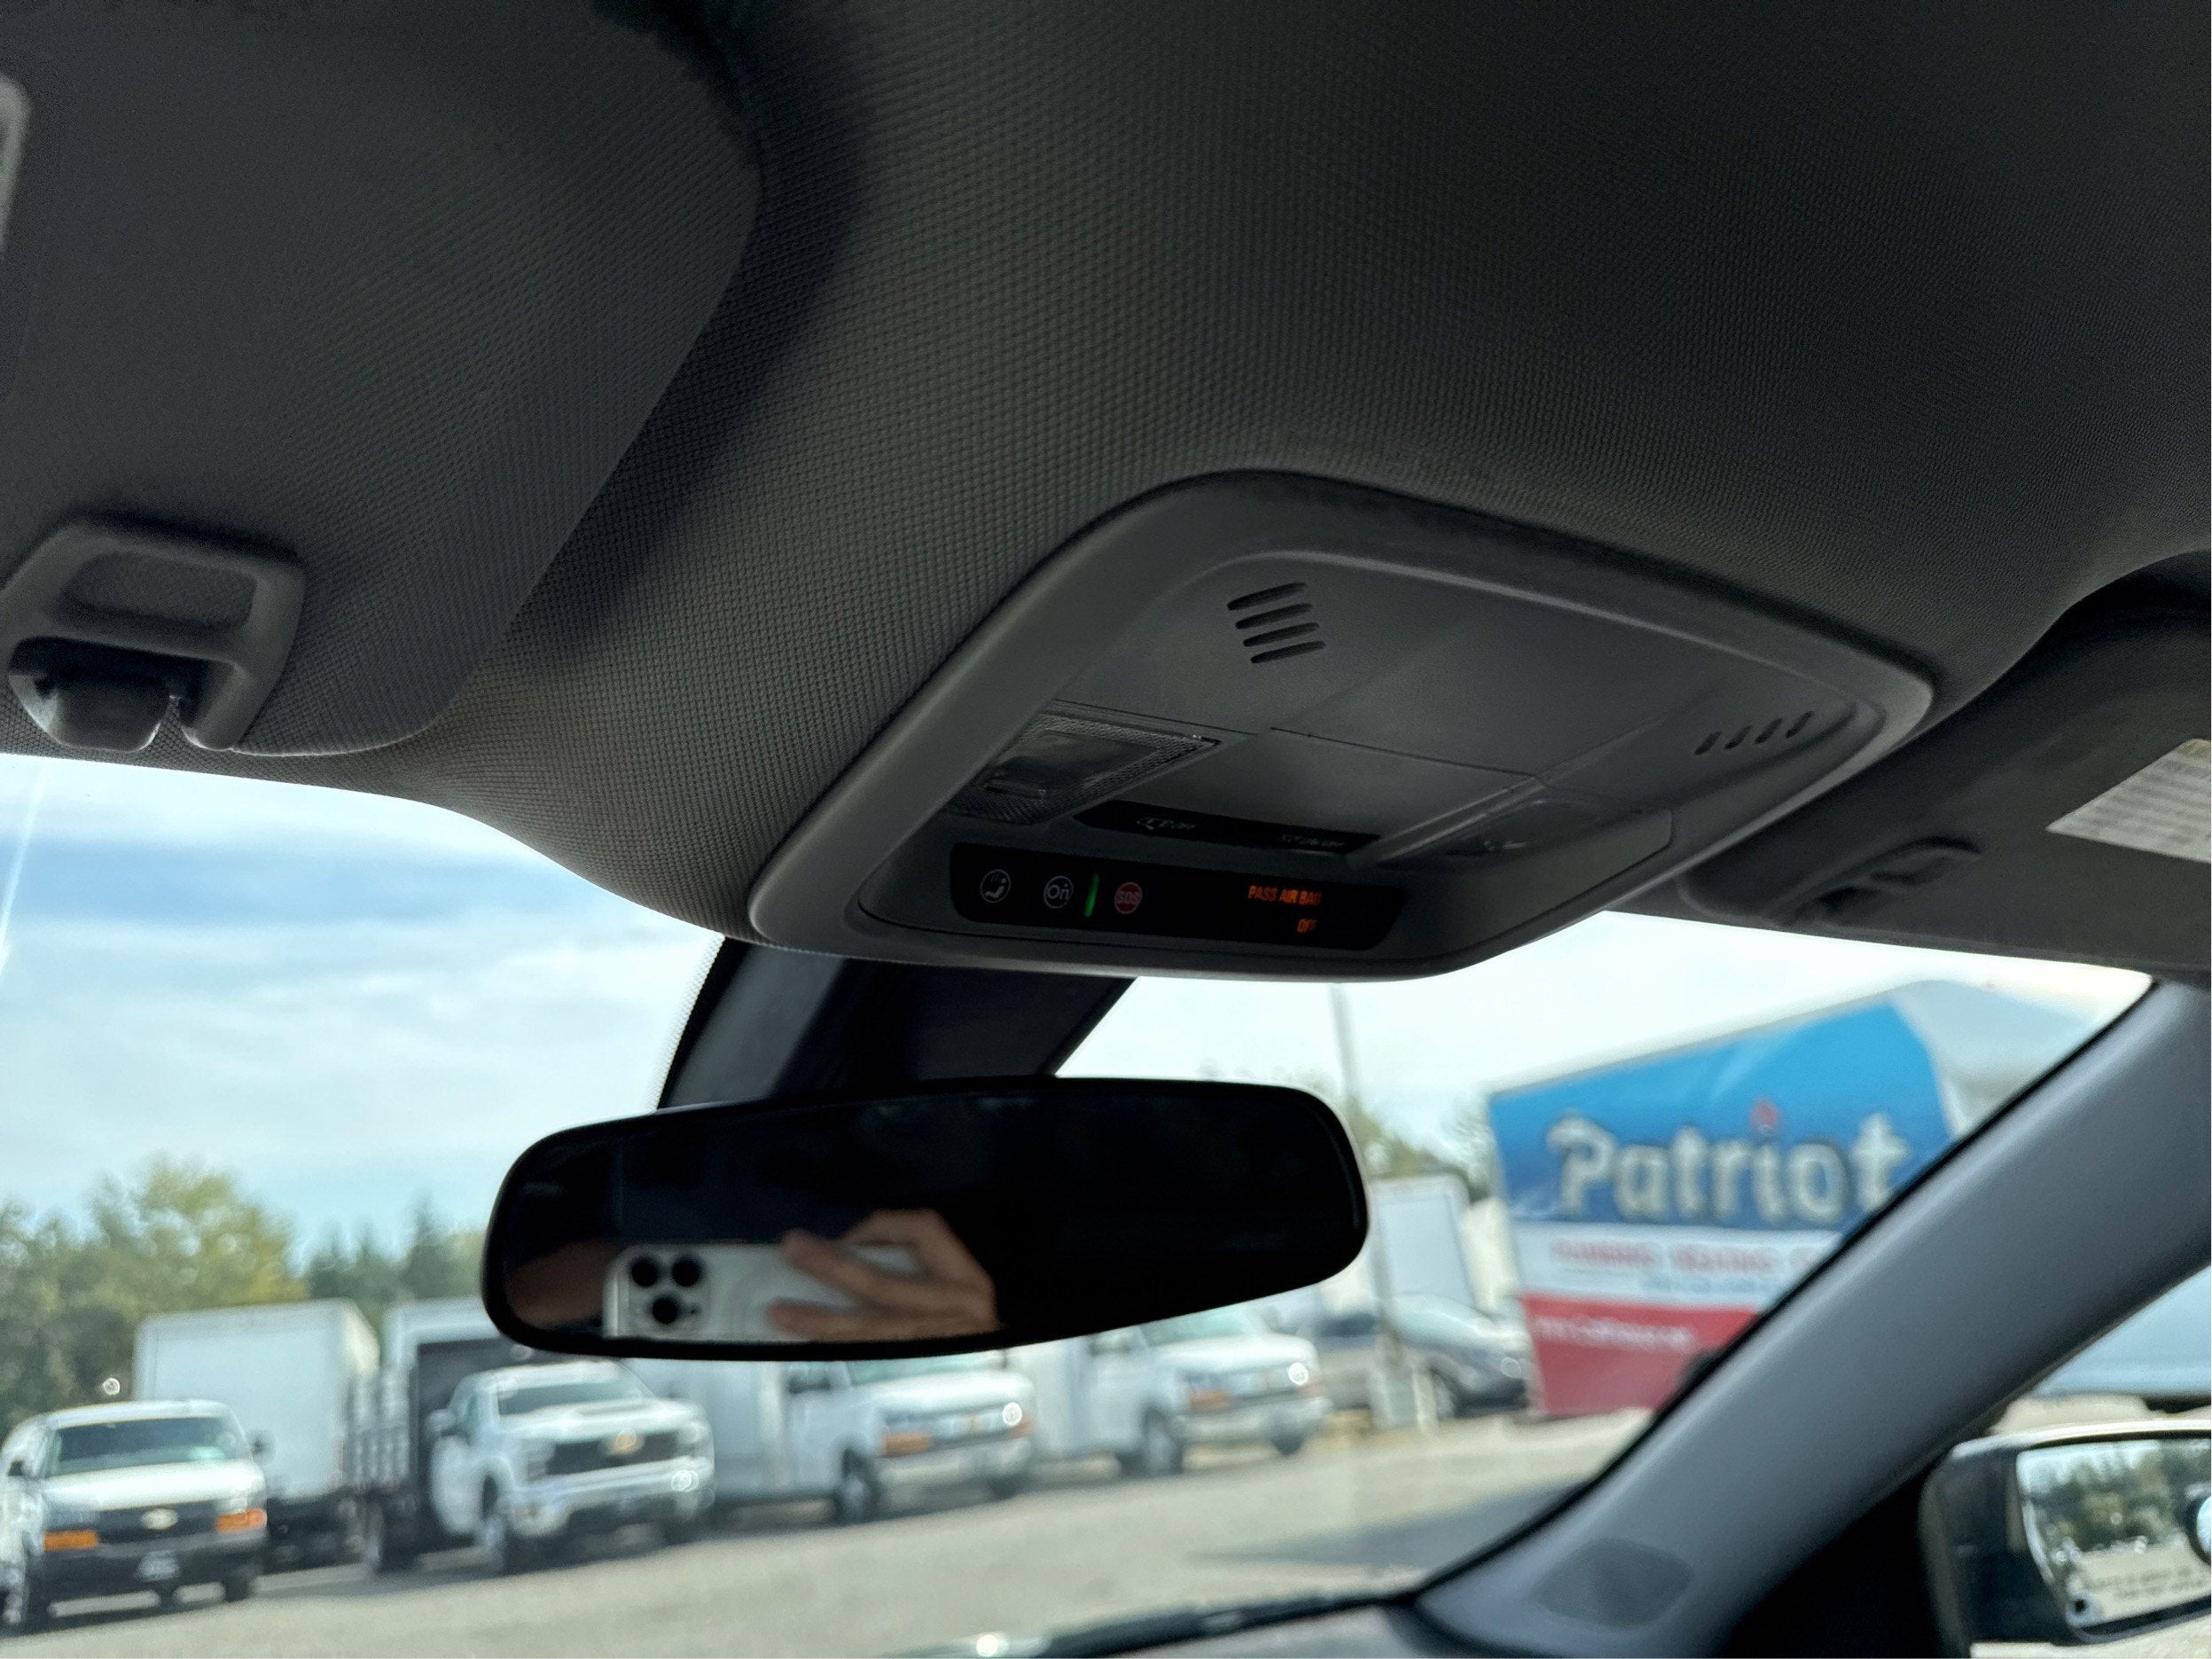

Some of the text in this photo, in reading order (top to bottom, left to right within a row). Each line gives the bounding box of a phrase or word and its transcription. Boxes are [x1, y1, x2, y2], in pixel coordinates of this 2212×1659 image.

[1047, 882, 1069, 900] On
[1115, 890, 1139, 905] SOS
[1247, 885, 1278, 902] PASS
[1278, 888, 1299, 904] AIR
[1544, 1098, 1910, 1225] Patriot
